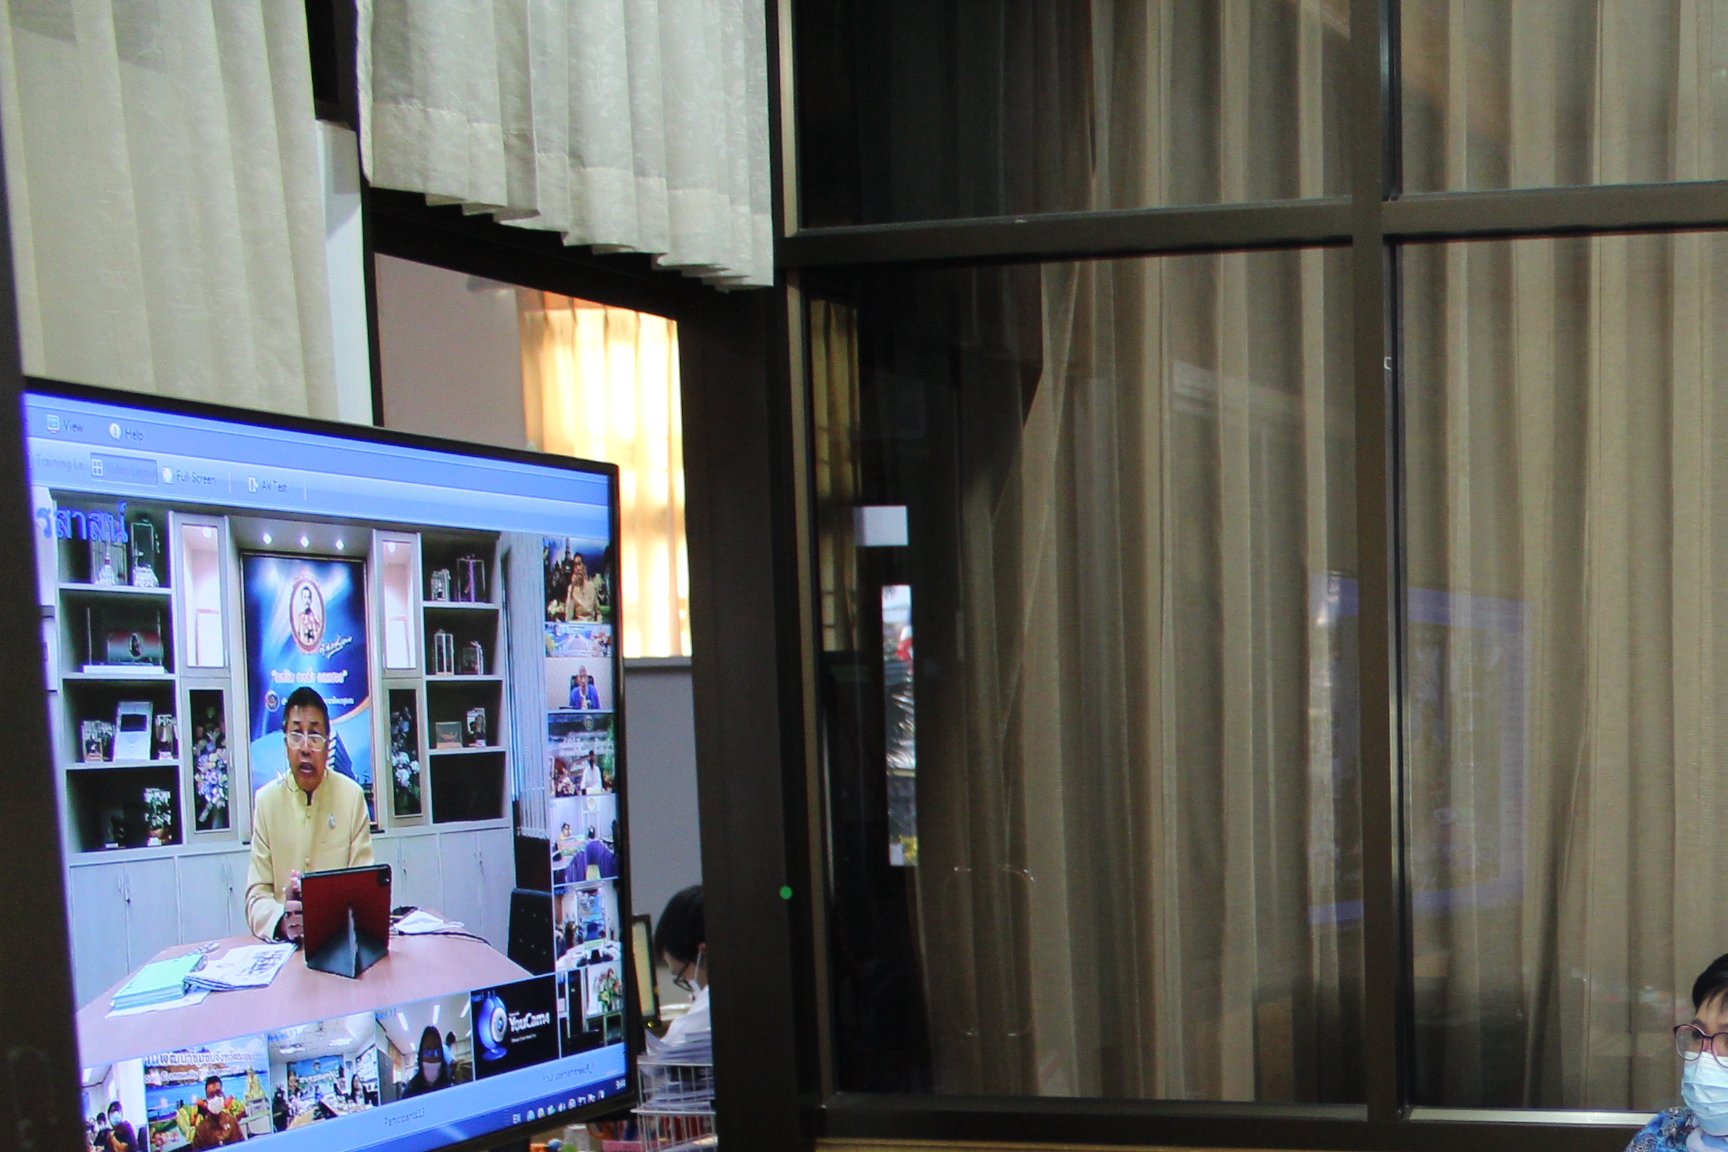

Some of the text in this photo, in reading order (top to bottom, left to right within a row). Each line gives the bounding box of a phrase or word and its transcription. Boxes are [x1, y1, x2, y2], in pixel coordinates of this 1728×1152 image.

[64, 420, 84, 433] View
[125, 427, 143, 441] Help
[176, 469, 216, 486] Full Screen
[261, 480, 288, 493] AV Test
